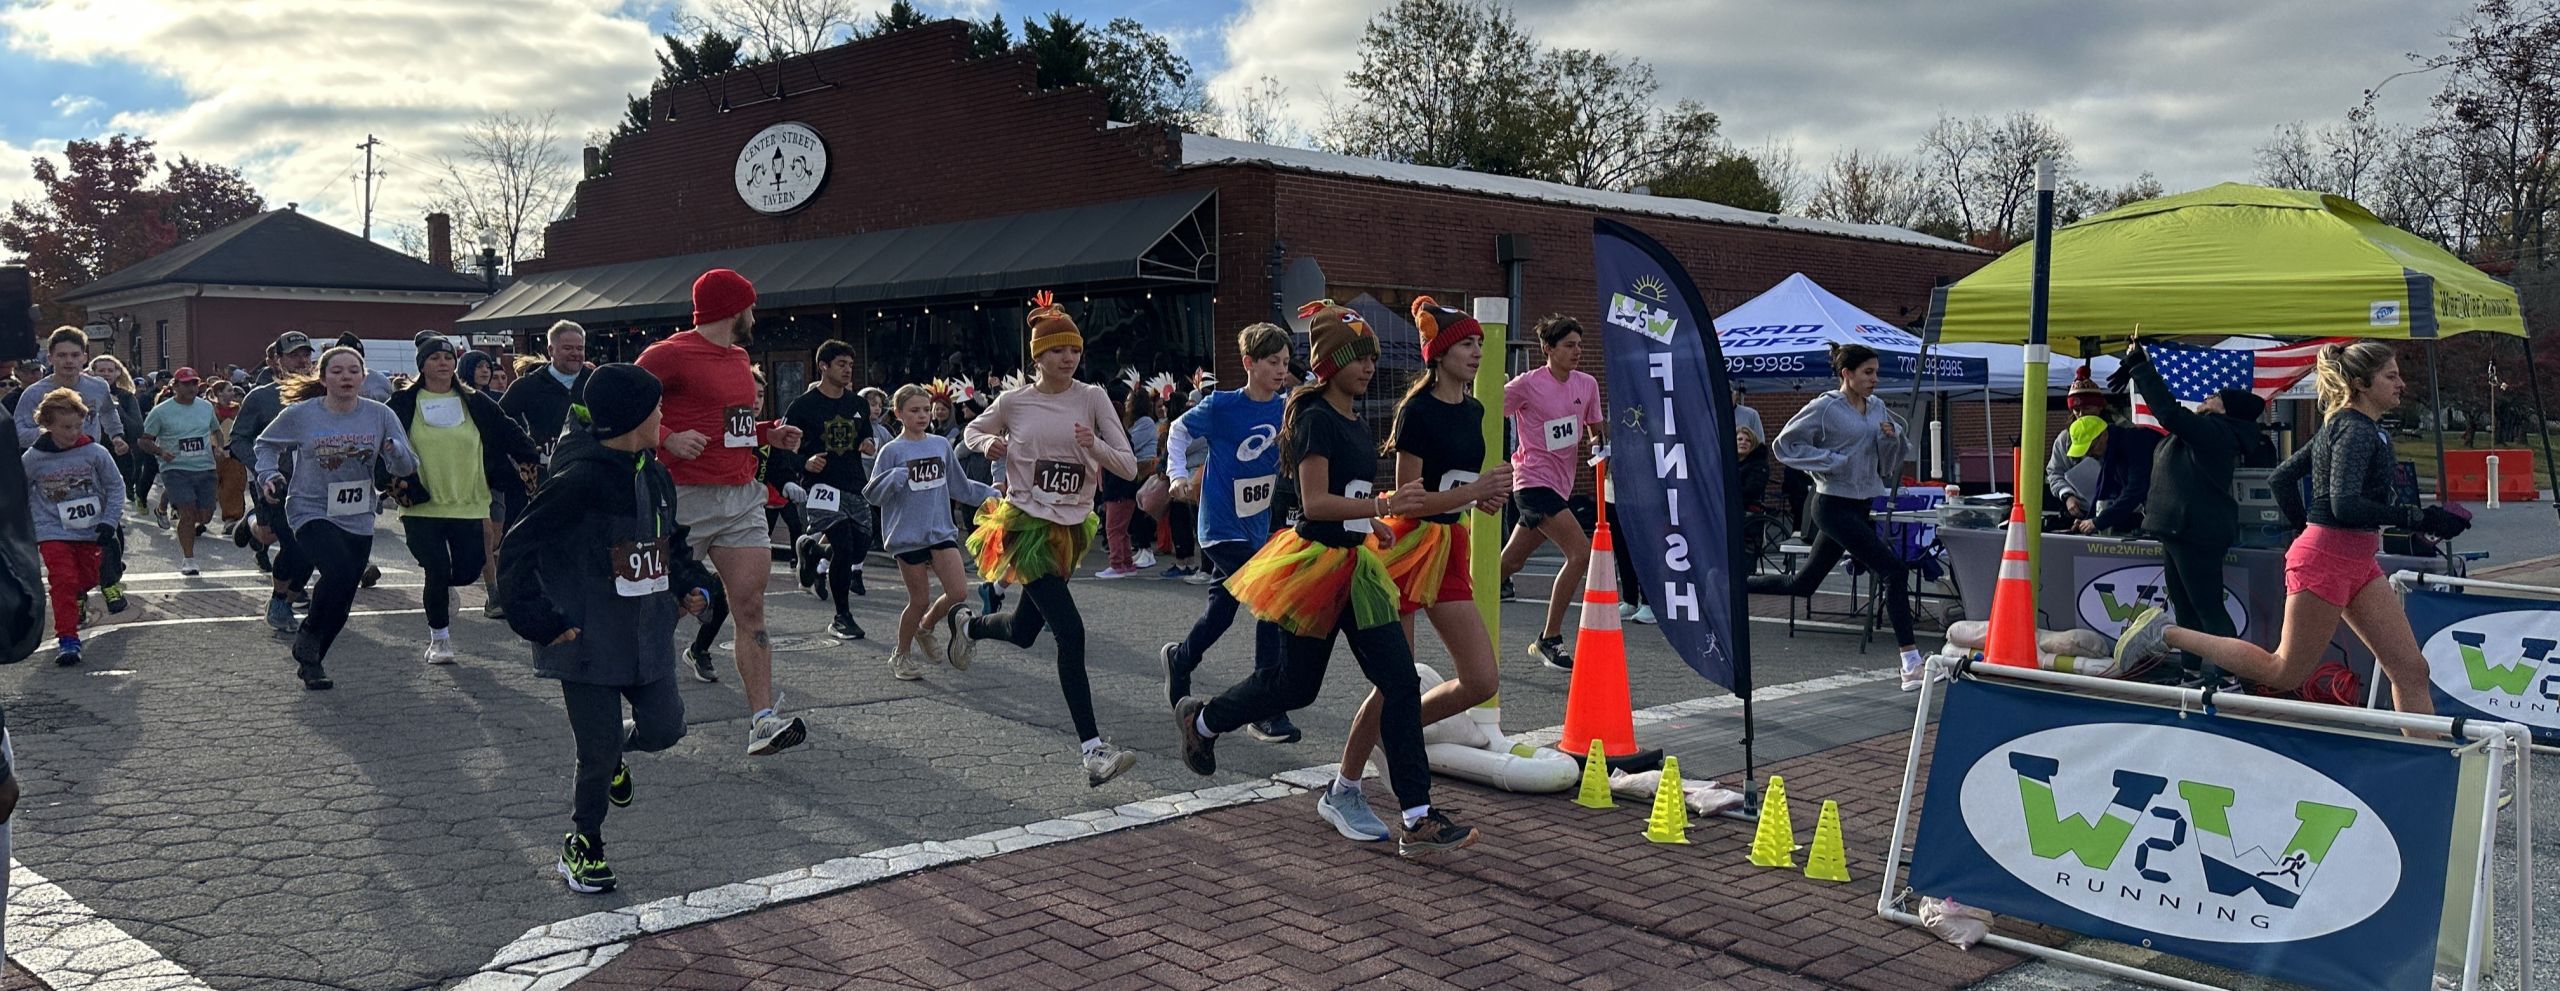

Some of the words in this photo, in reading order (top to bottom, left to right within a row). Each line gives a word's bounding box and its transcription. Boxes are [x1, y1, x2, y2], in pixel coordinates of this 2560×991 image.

[744, 133, 776, 163] CENTER
[782, 131, 816, 151] STREET
[763, 190, 796, 206] TAVERN
[1723, 325, 1824, 337] RAD
[1718, 336, 1826, 348] OOFS
[1723, 355, 1805, 373] 99-9985
[731, 415, 757, 435] 149
[1552, 422, 1573, 439] 314
[182, 440, 202, 452] 1471
[912, 464, 939, 481] 1449
[1041, 470, 1080, 492] 1450
[337, 487, 363, 504] 473
[815, 488, 834, 502] 724
[1243, 483, 1270, 503] 686
[67, 503, 96, 520] 280
[629, 549, 663, 578] 914
[2009, 751, 2357, 909] W2W
[2057, 872, 2270, 929] RUNNING
